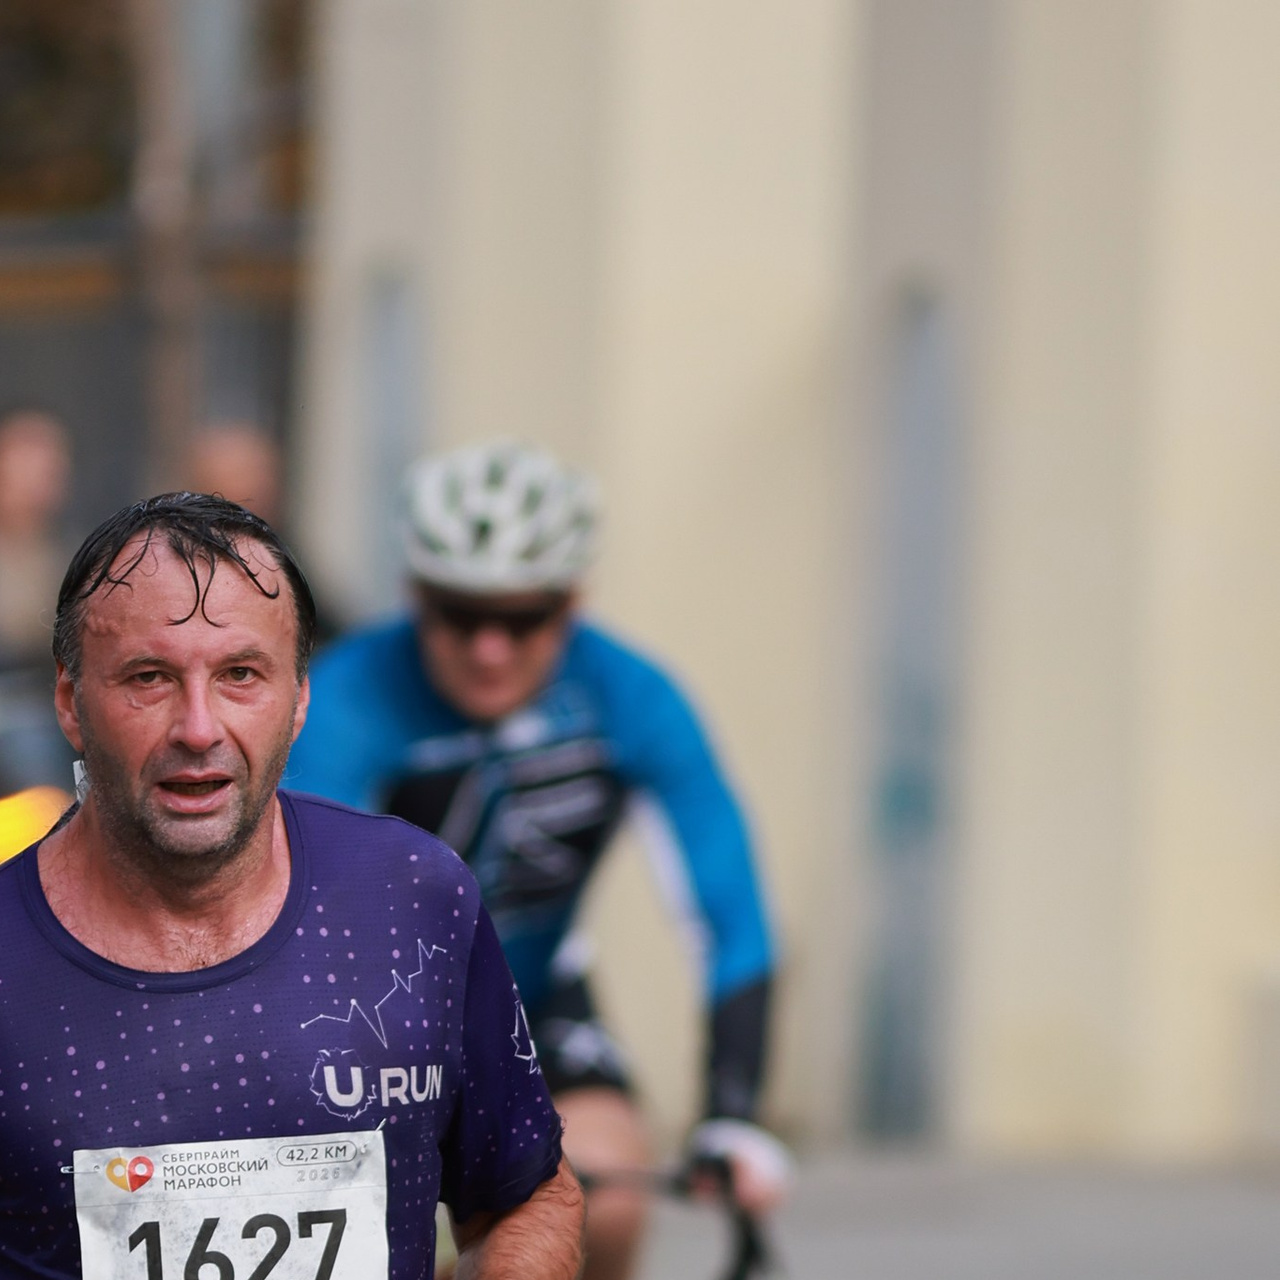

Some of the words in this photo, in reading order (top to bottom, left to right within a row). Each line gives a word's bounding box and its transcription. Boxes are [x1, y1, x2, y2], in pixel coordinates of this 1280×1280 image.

[323, 1065, 364, 1107] U
[380, 1065, 443, 1107] RUN
[162, 1149, 240, 1164] СБЕРПРАЙМ
[285, 1148, 318, 1163] 42,2
[324, 1145, 347, 1159] КМ
[163, 1158, 269, 1177] МОСКОВСКИЙ
[164, 1175, 242, 1191] МАРАФОН
